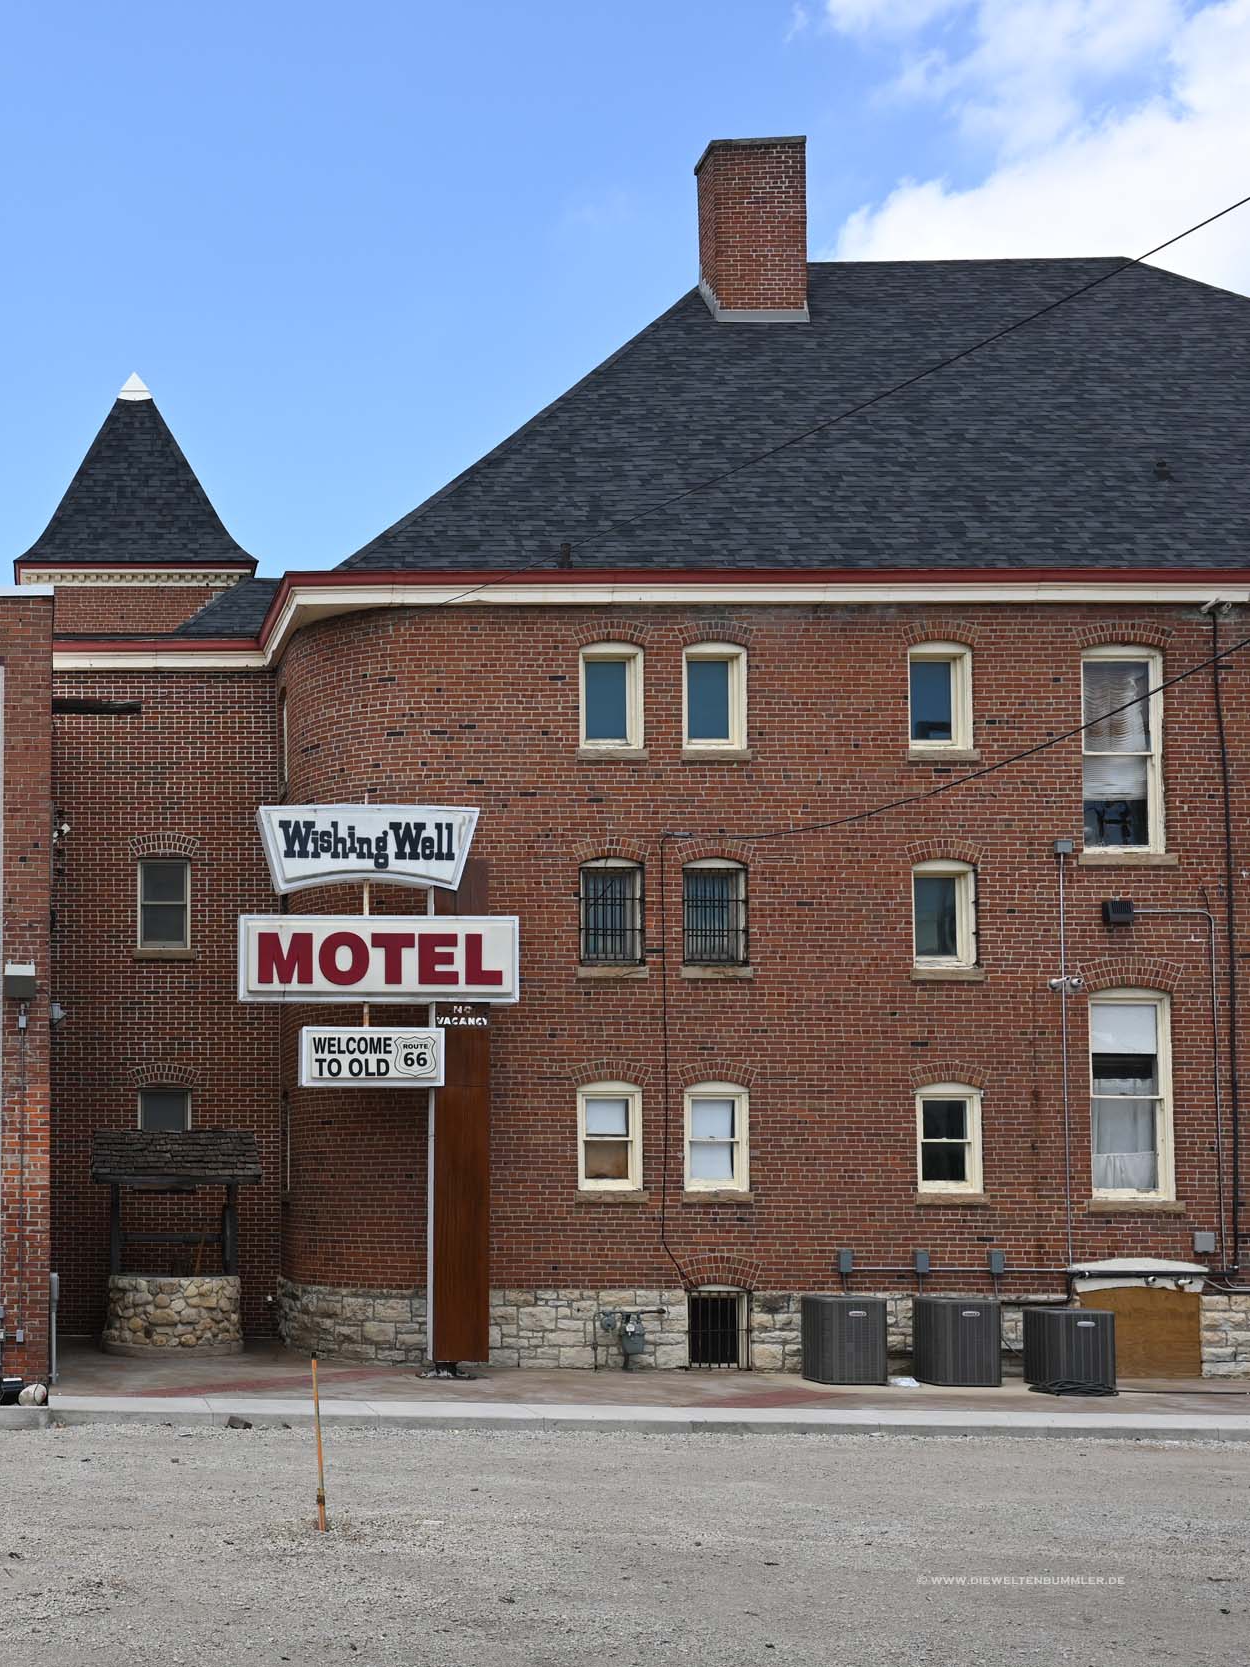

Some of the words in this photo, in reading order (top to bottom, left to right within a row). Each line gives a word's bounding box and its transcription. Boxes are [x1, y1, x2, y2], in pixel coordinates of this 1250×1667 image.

[279, 820, 389, 869] Wishing
[389, 821, 455, 861] Well
[257, 931, 503, 986] MOTEL
[436, 1016, 488, 1026] VACANCY
[312, 1036, 393, 1056] WELCOME
[402, 1043, 429, 1051] ROUTE
[314, 1058, 343, 1077] TO
[348, 1058, 390, 1077] OLD
[402, 1052, 428, 1068] 66
